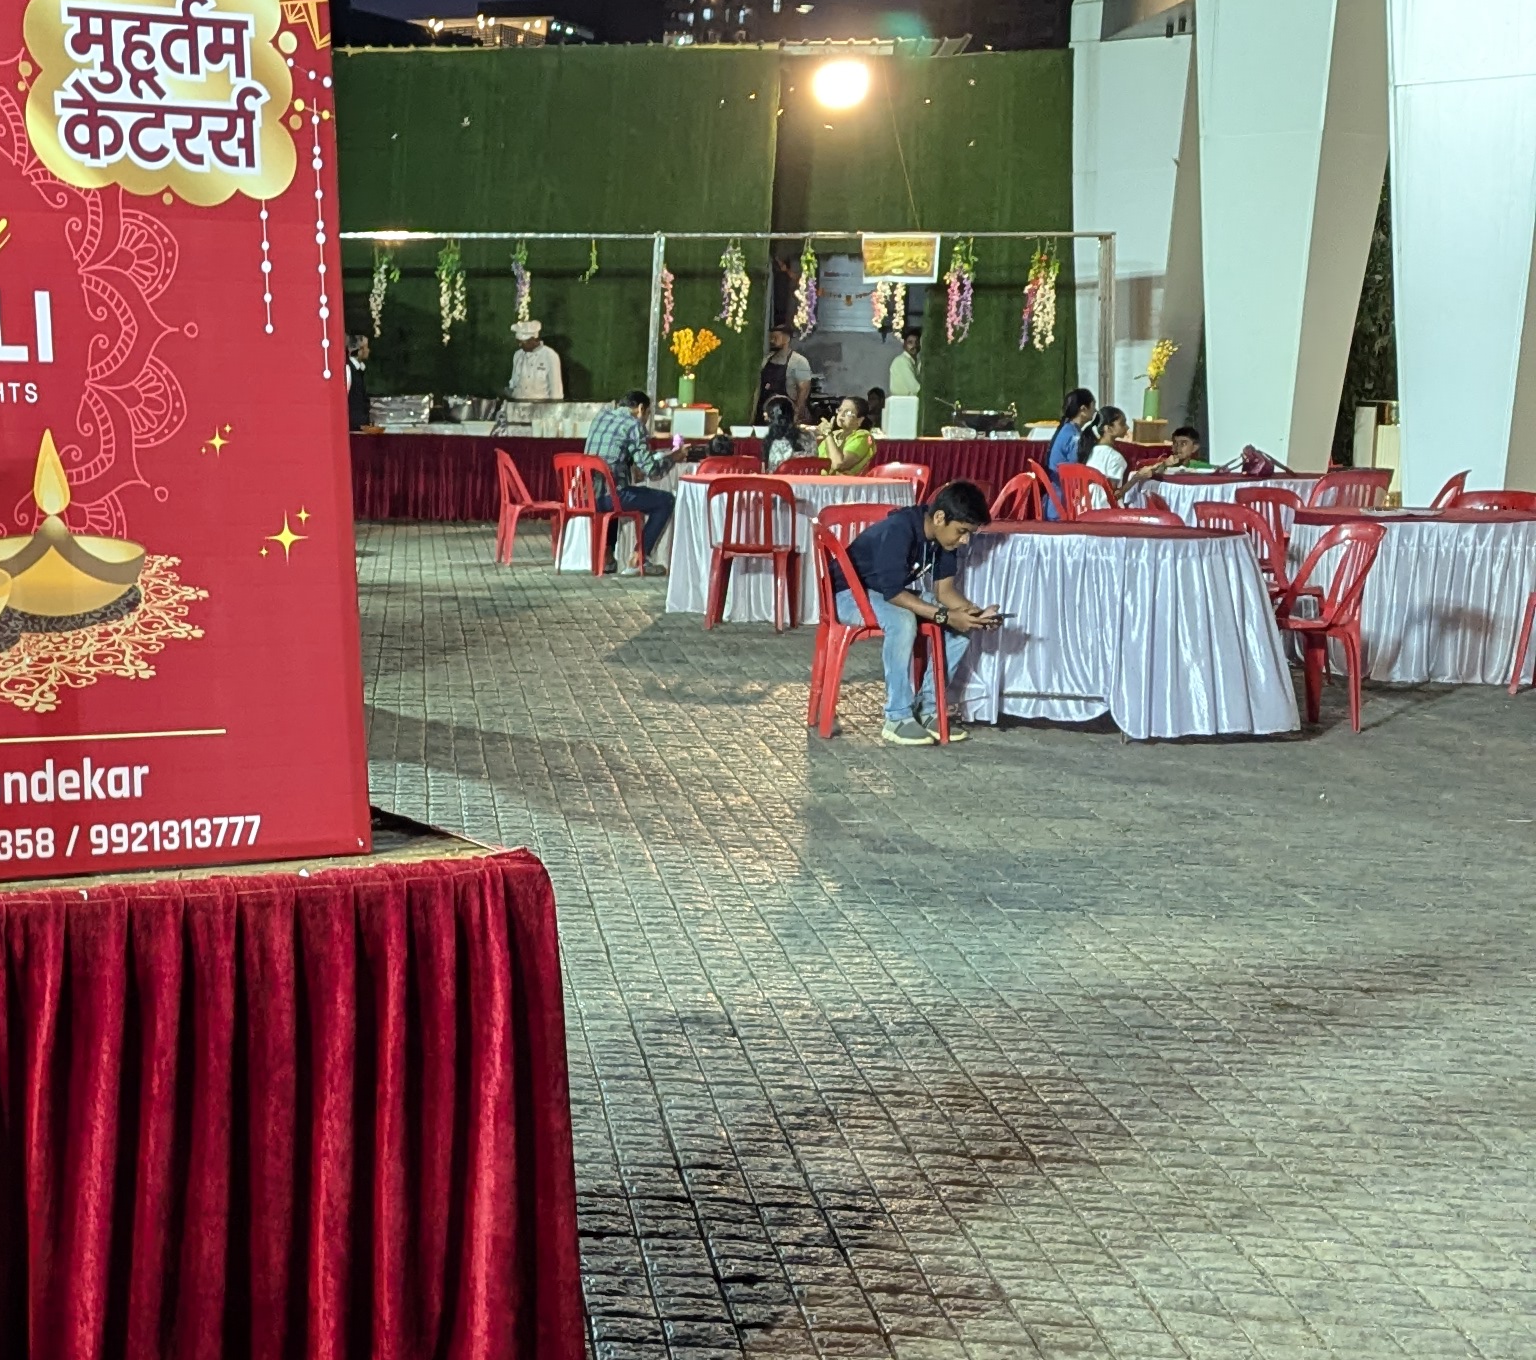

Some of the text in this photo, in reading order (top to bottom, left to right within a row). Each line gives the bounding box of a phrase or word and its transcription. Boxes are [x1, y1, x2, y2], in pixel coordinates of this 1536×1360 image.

[60, 78, 263, 169] केटरर्स
[65, 825, 80, 858] /
[89, 814, 262, 856] 9921313777
